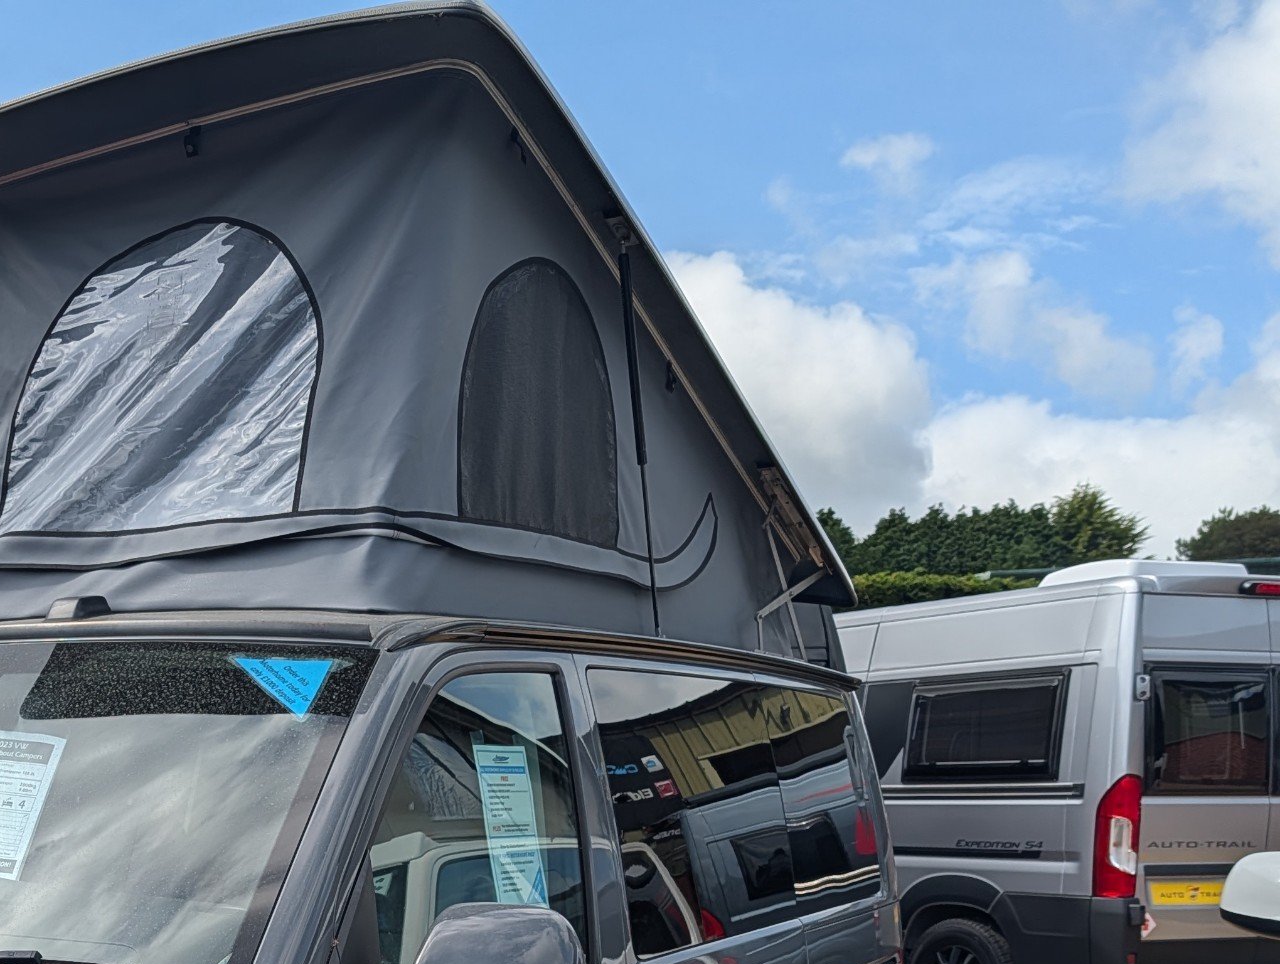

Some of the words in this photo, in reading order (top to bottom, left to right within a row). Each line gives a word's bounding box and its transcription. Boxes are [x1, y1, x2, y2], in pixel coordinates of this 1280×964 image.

[14, 742, 30, 750] VW
[15, 751, 44, 760] Campers
[1024, 841, 1044, 849] S4
